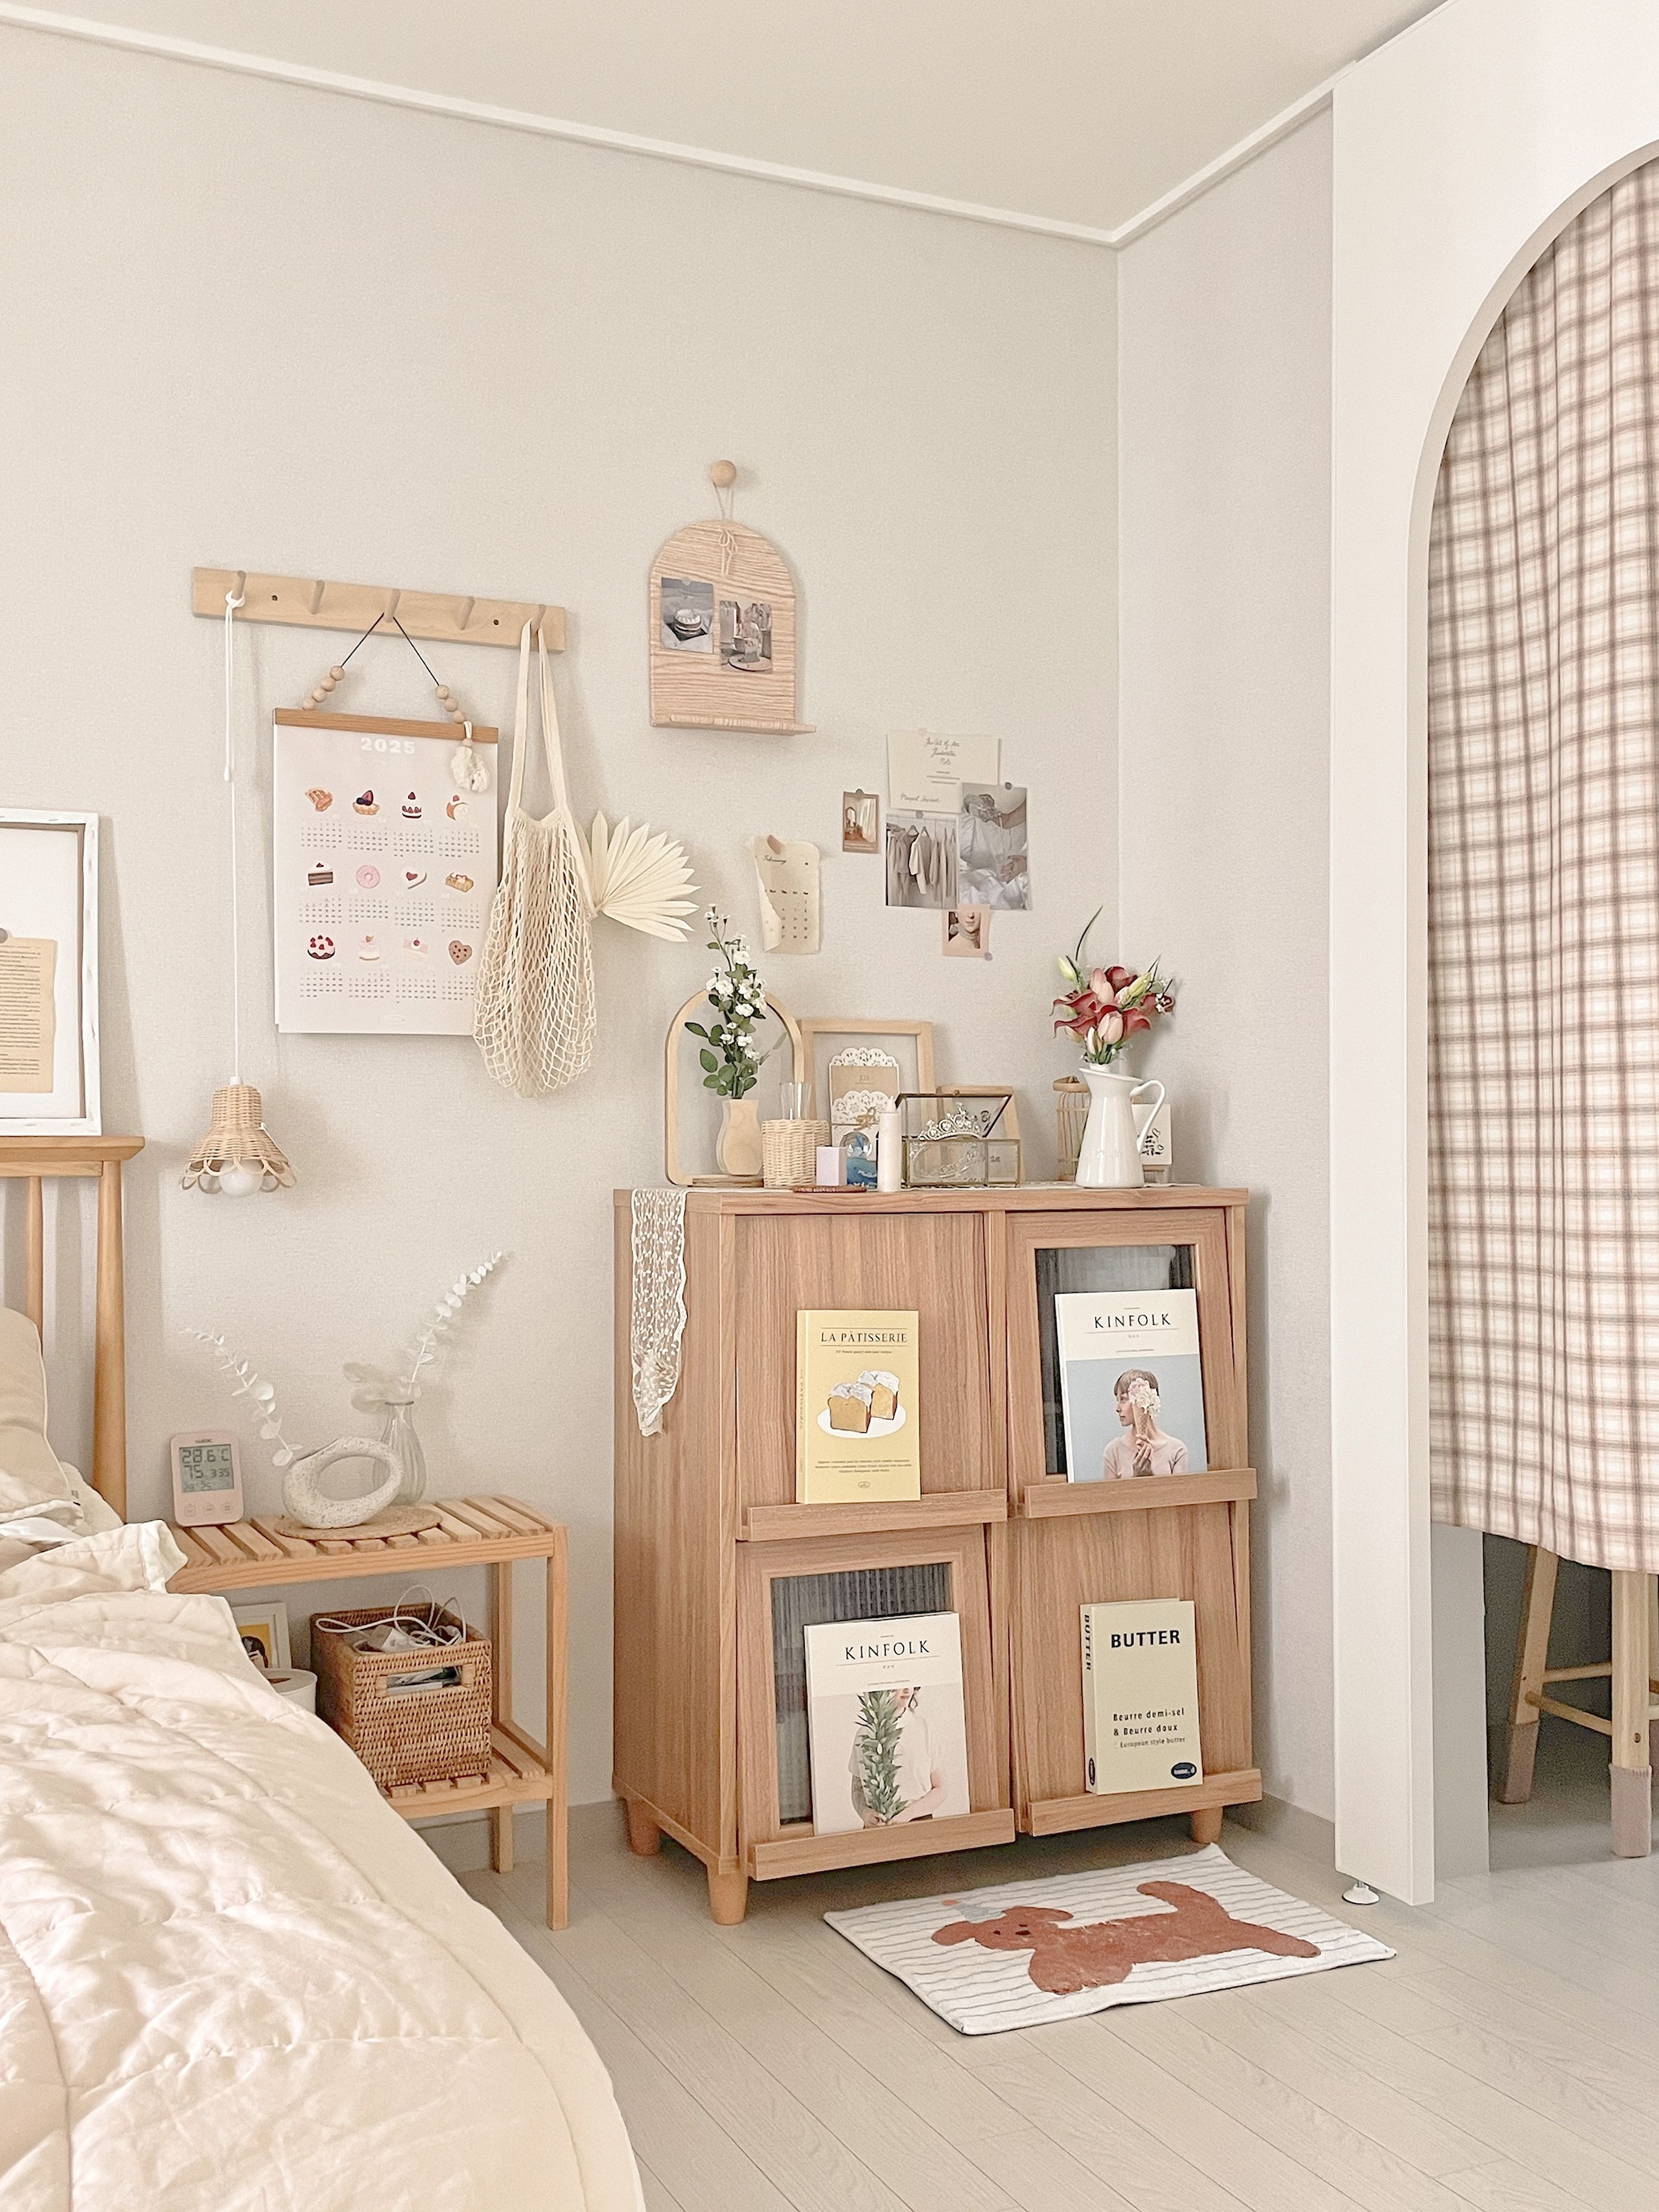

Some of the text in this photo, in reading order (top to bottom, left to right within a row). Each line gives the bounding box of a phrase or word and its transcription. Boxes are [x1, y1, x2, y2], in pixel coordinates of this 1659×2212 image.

[360, 736, 415, 754] 2025
[1094, 1313, 1171, 1329] KINFOLK
[820, 1330, 908, 1343] LA PÂTISSERIE
[1111, 1629, 1181, 1648] BUTTER
[844, 1640, 930, 1660] KINFOLK
[1113, 1707, 1185, 1721] Beurre demi-sel
[1113, 1724, 1178, 1736] & Beurre doux
